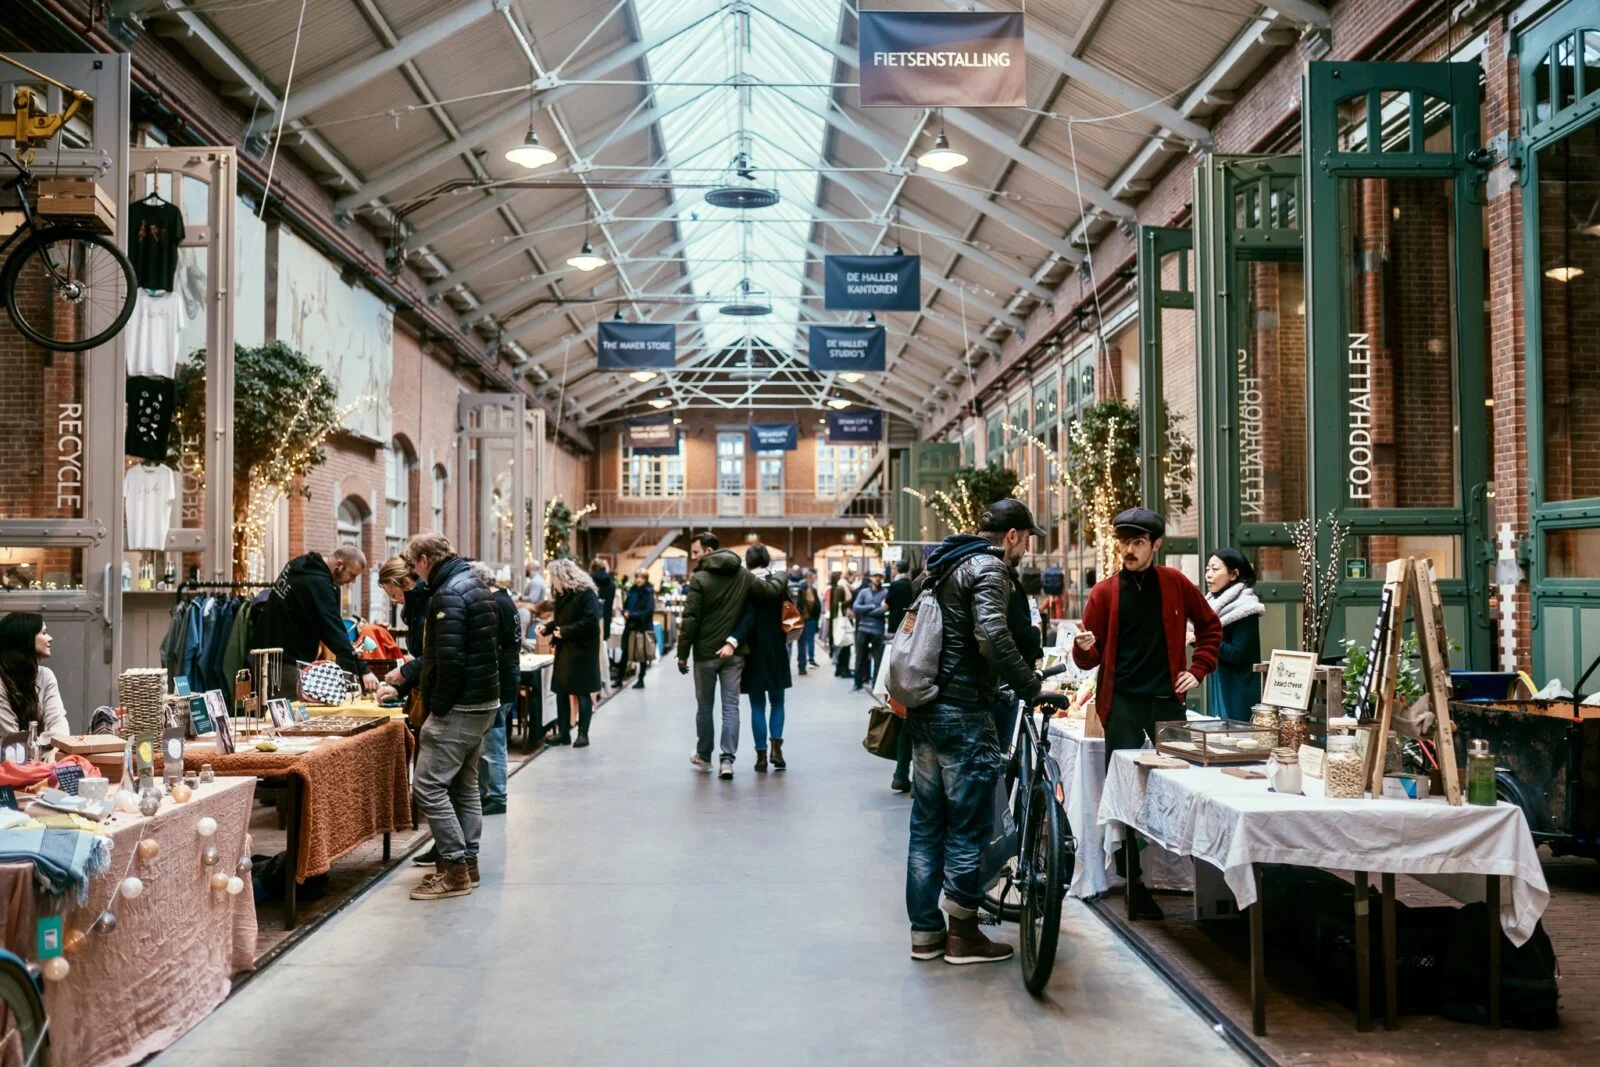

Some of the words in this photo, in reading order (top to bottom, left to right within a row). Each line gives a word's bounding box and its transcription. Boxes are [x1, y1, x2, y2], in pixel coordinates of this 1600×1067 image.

[873, 51, 1011, 67] FIETSENSTALLING
[846, 272, 860, 282] DE
[861, 272, 898, 282] HALLEN
[847, 284, 898, 294] KANTOREN
[602, 341, 618, 350] THE
[619, 341, 646, 350] MAKER
[646, 341, 671, 350] STORE
[826, 339, 837, 348] DE
[838, 339, 868, 348] HALLEN
[829, 349, 866, 358] STUDIO'S
[1348, 332, 1372, 499] FOODHALLEN
[57, 403, 82, 509] RECYCLE
